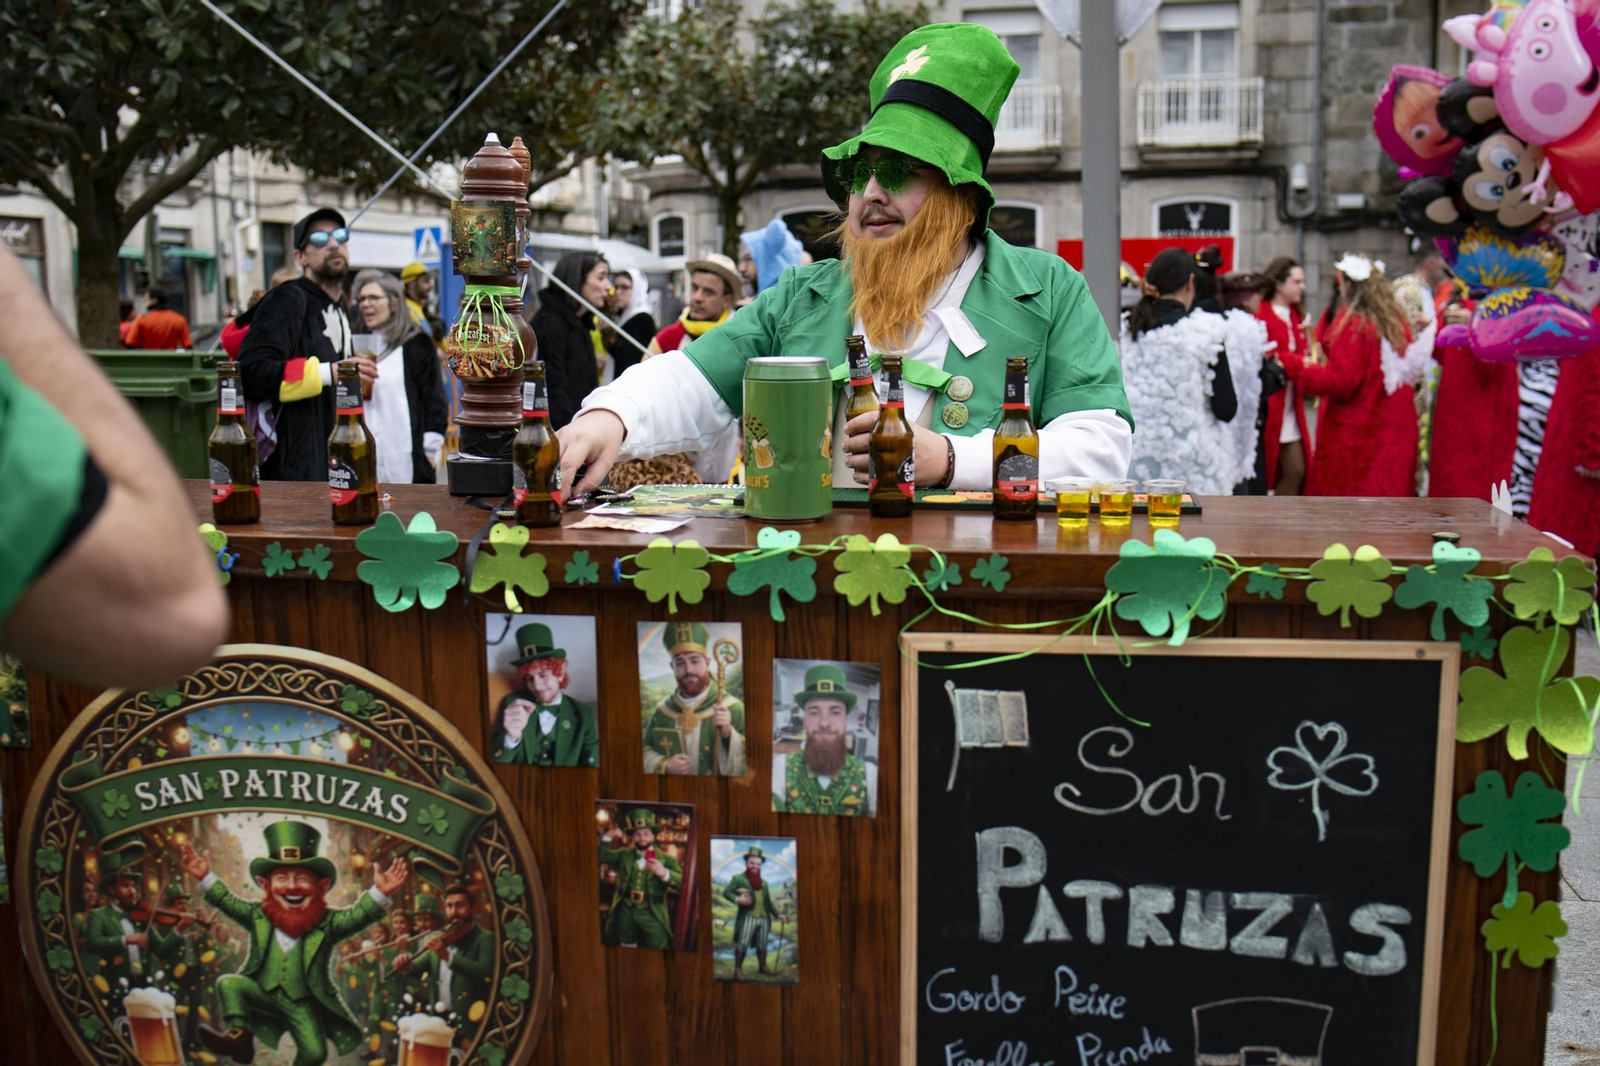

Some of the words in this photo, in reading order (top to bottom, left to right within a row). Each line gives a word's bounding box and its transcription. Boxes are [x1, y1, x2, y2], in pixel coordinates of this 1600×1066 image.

[134, 771, 204, 811] SAN
[218, 768, 410, 824] PATRUZAS
[1054, 726, 1232, 820] San
[975, 826, 1413, 977] PATRUZAS
[926, 967, 1027, 1014] Gordo
[1054, 964, 1127, 1019] Peixe
[1076, 1026, 1172, 1066] Prenda
